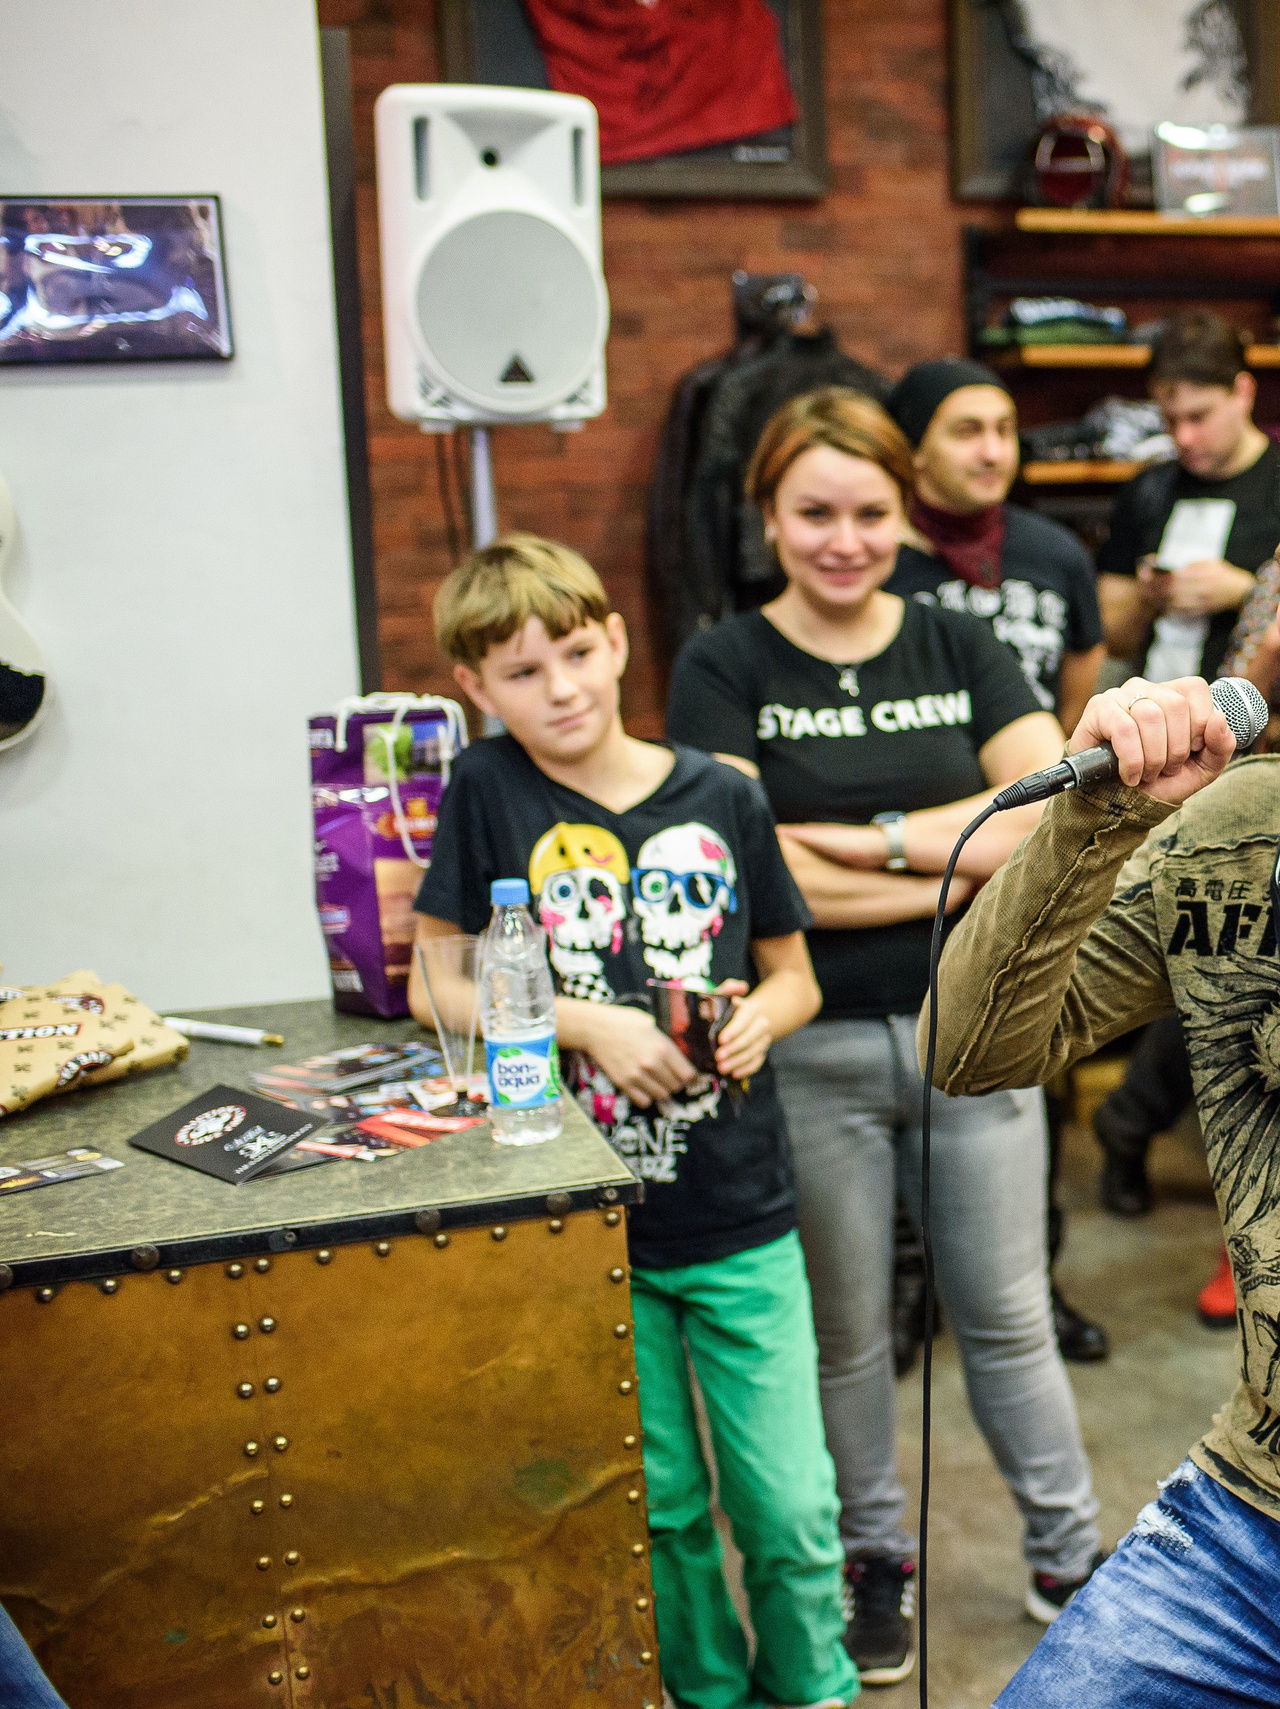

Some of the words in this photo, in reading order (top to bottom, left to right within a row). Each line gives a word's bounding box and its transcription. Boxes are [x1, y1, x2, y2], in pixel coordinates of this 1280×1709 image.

[757, 704, 867, 740] STAGE
[871, 690, 972, 732] CREW
[498, 1073, 540, 1091] aqua
